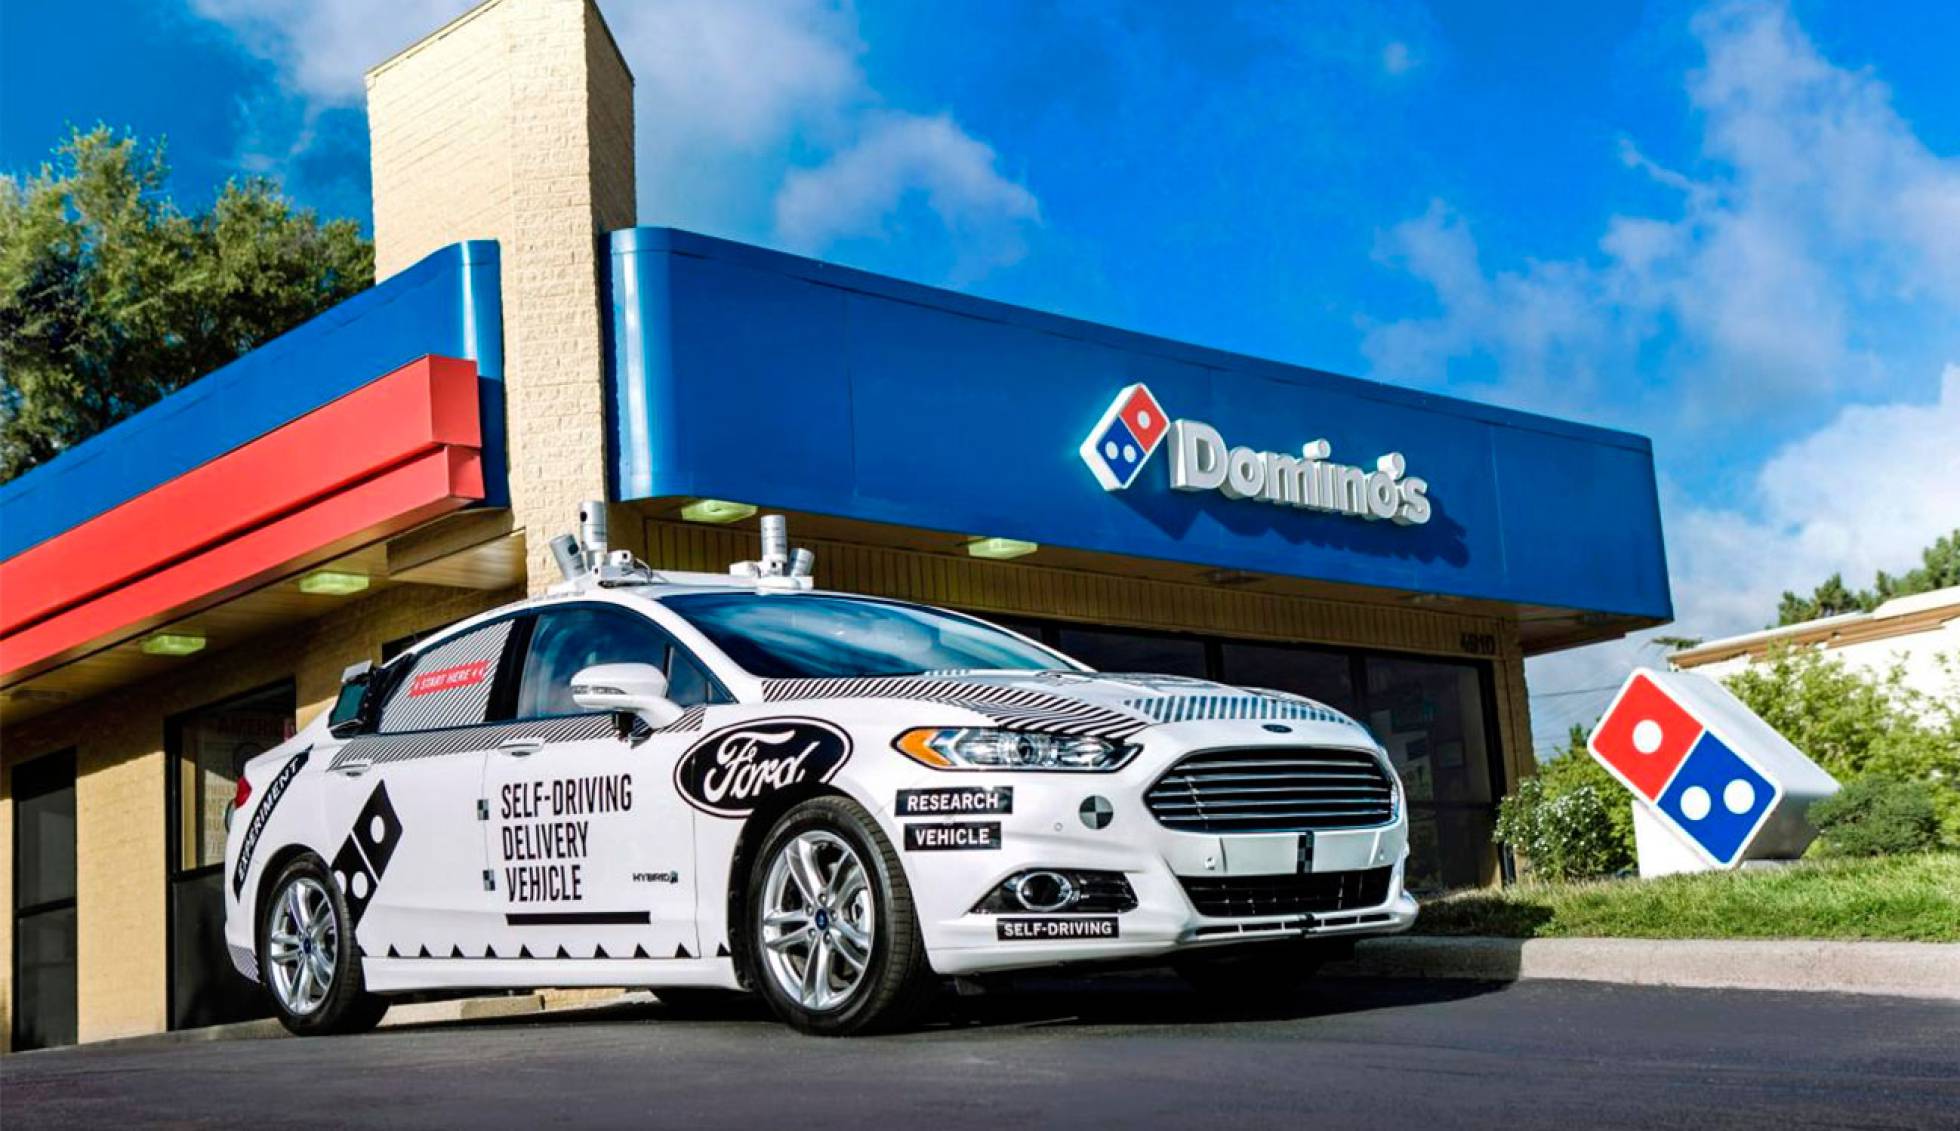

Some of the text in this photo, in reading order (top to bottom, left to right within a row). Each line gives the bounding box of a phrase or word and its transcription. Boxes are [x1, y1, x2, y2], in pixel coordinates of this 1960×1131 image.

[1168, 419, 1431, 525] Domino's
[703, 729, 820, 803] Ford
[501, 773, 632, 820] SELF-DRIVING
[907, 793, 999, 812] RESEARCH
[238, 757, 300, 882] EXPERIMENT
[915, 828, 990, 846] VEHICLE
[502, 821, 589, 861] DELIVERY
[506, 864, 582, 903] VEHICLE
[632, 872, 670, 883] HYBRID
[1004, 921, 1112, 937] SELF-DRIVING
